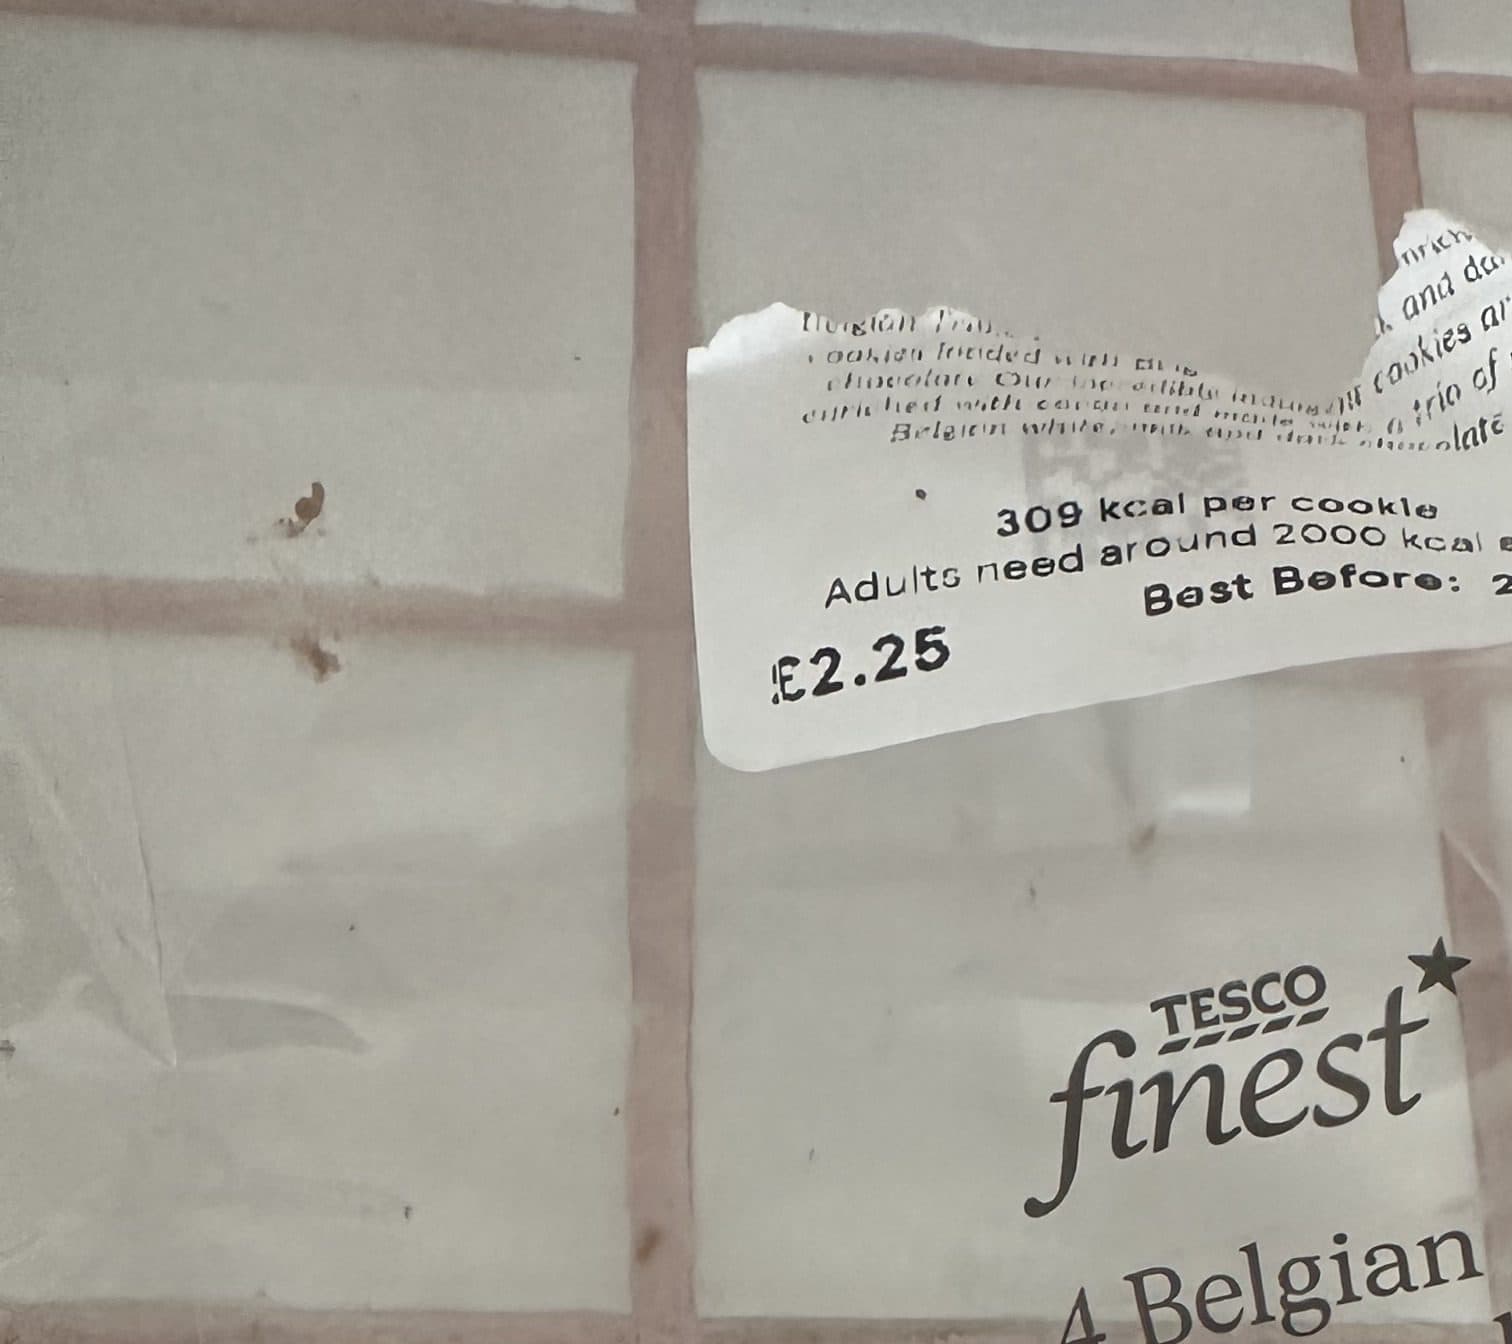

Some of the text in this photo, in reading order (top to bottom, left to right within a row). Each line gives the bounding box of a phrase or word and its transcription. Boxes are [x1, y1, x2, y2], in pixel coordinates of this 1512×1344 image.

[1372, 322, 1472, 394] cookies
[1472, 347, 1499, 395] of
[996, 491, 1439, 538] 309 kcal per cookie
[824, 565, 962, 609] Adults
[976, 543, 1086, 585] need
[1099, 523, 1258, 568] around
[1272, 522, 1387, 548] 2000
[1401, 527, 1485, 554] kcal
[1142, 572, 1255, 617] Best
[1272, 563, 1461, 597] Before:
[770, 624, 952, 706] £2.25
[1149, 964, 1328, 1037] TESCO
[1023, 984, 1430, 1219] finest
